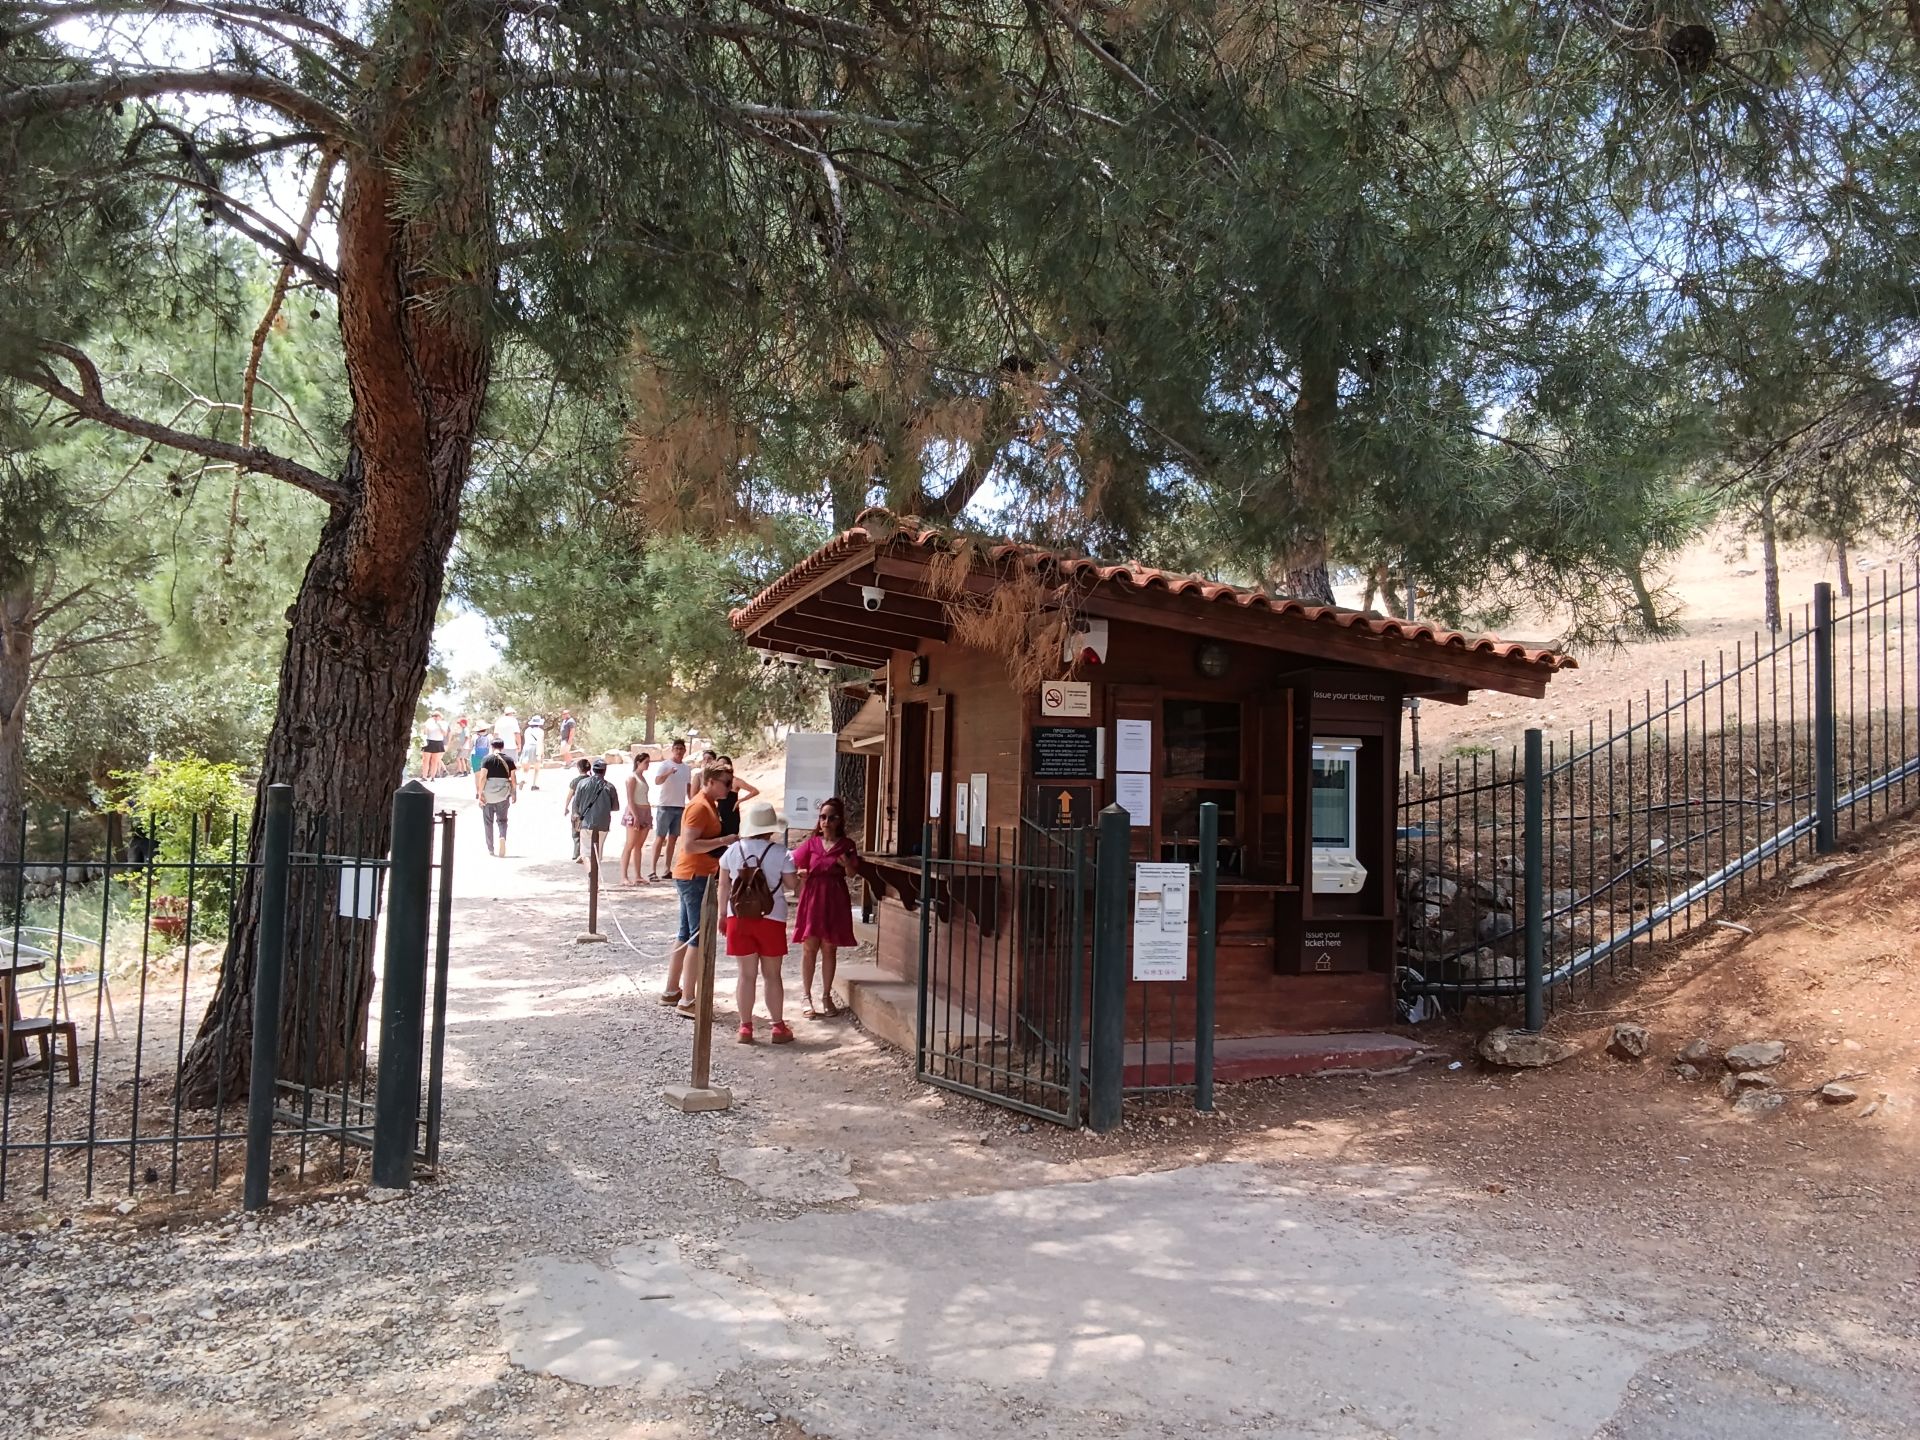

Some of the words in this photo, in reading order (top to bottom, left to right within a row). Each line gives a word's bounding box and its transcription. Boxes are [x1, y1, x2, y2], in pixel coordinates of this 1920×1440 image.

[1313, 690, 1332, 698] Issue
[1332, 693, 1348, 701] your
[1349, 692, 1368, 701] ticket
[1369, 693, 1385, 702] here
[1305, 931, 1324, 939] Issue
[1324, 932, 1340, 940] your
[1305, 939, 1324, 947] ticket
[1325, 939, 1342, 947] here
